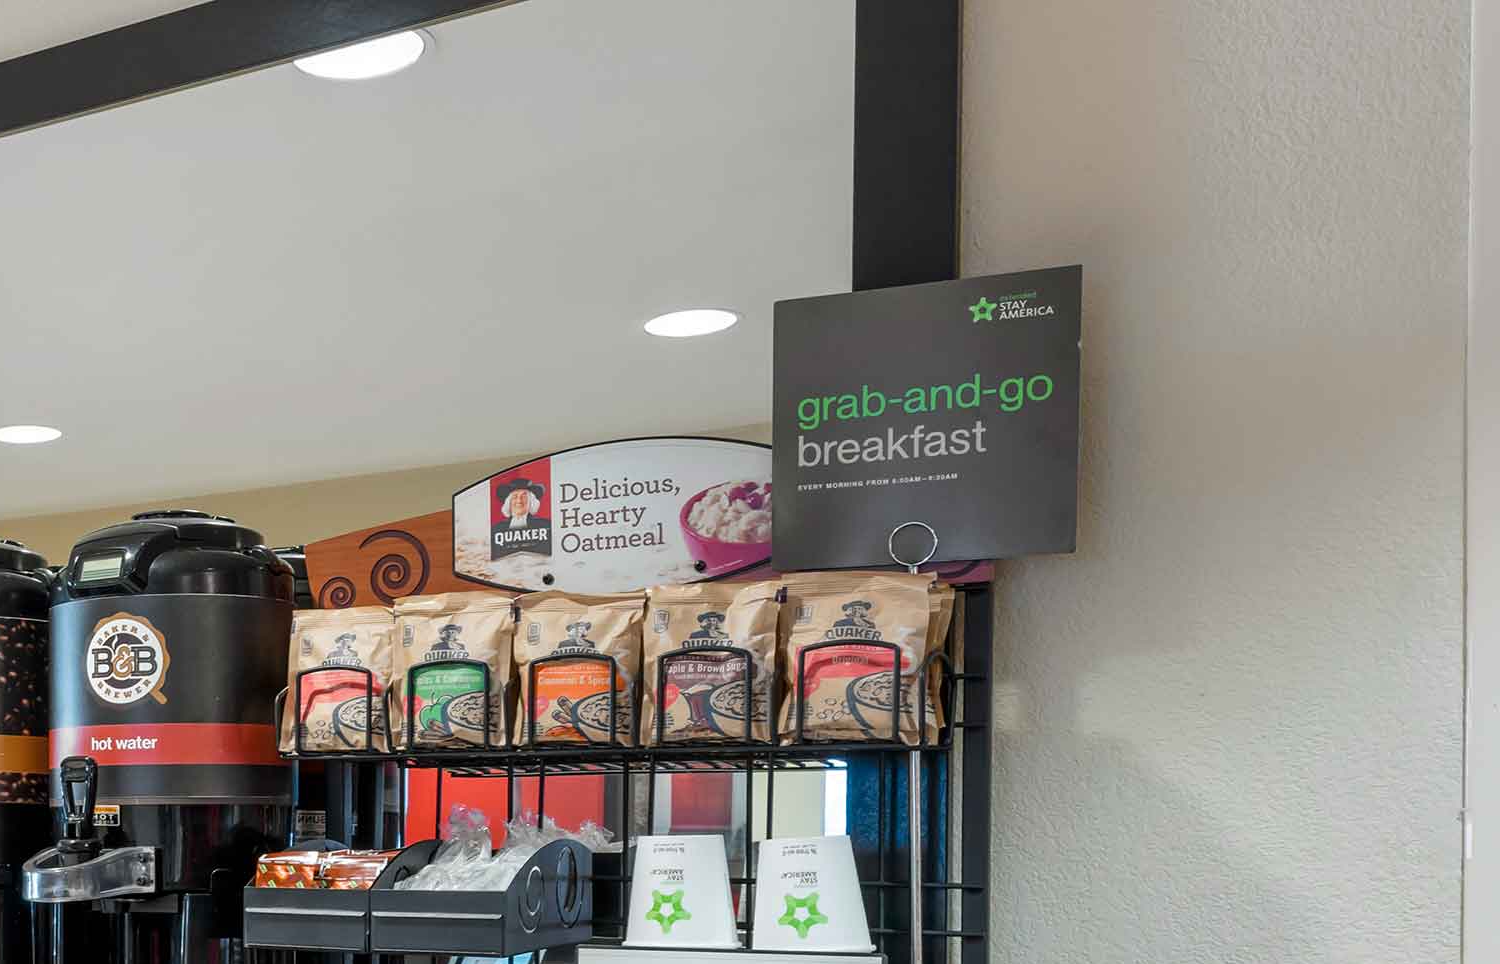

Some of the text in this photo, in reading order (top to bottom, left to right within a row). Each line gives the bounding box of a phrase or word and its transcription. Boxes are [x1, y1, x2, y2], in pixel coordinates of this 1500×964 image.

[999, 300, 1028, 312] STAY
[999, 305, 1054, 320] AMERICA
[796, 373, 1054, 431] grab-and-go
[797, 421, 987, 468] breakfast
[559, 476, 681, 504] Delicious,
[826, 480, 864, 489] MORNING
[866, 478, 889, 487] FROM
[560, 504, 646, 529] Hearty
[494, 528, 549, 546] QUAKER
[560, 523, 665, 554] Oatmeal
[97, 624, 139, 646] BAKER
[825, 628, 882, 641] QUAKER
[91, 645, 158, 679] B&B
[423, 650, 469, 662] QUAKER
[664, 662, 686, 674] aple
[688, 663, 695, 673] &
[697, 663, 725, 673] Brown
[97, 679, 152, 699] BREWER
[91, 737, 158, 751] hot water
